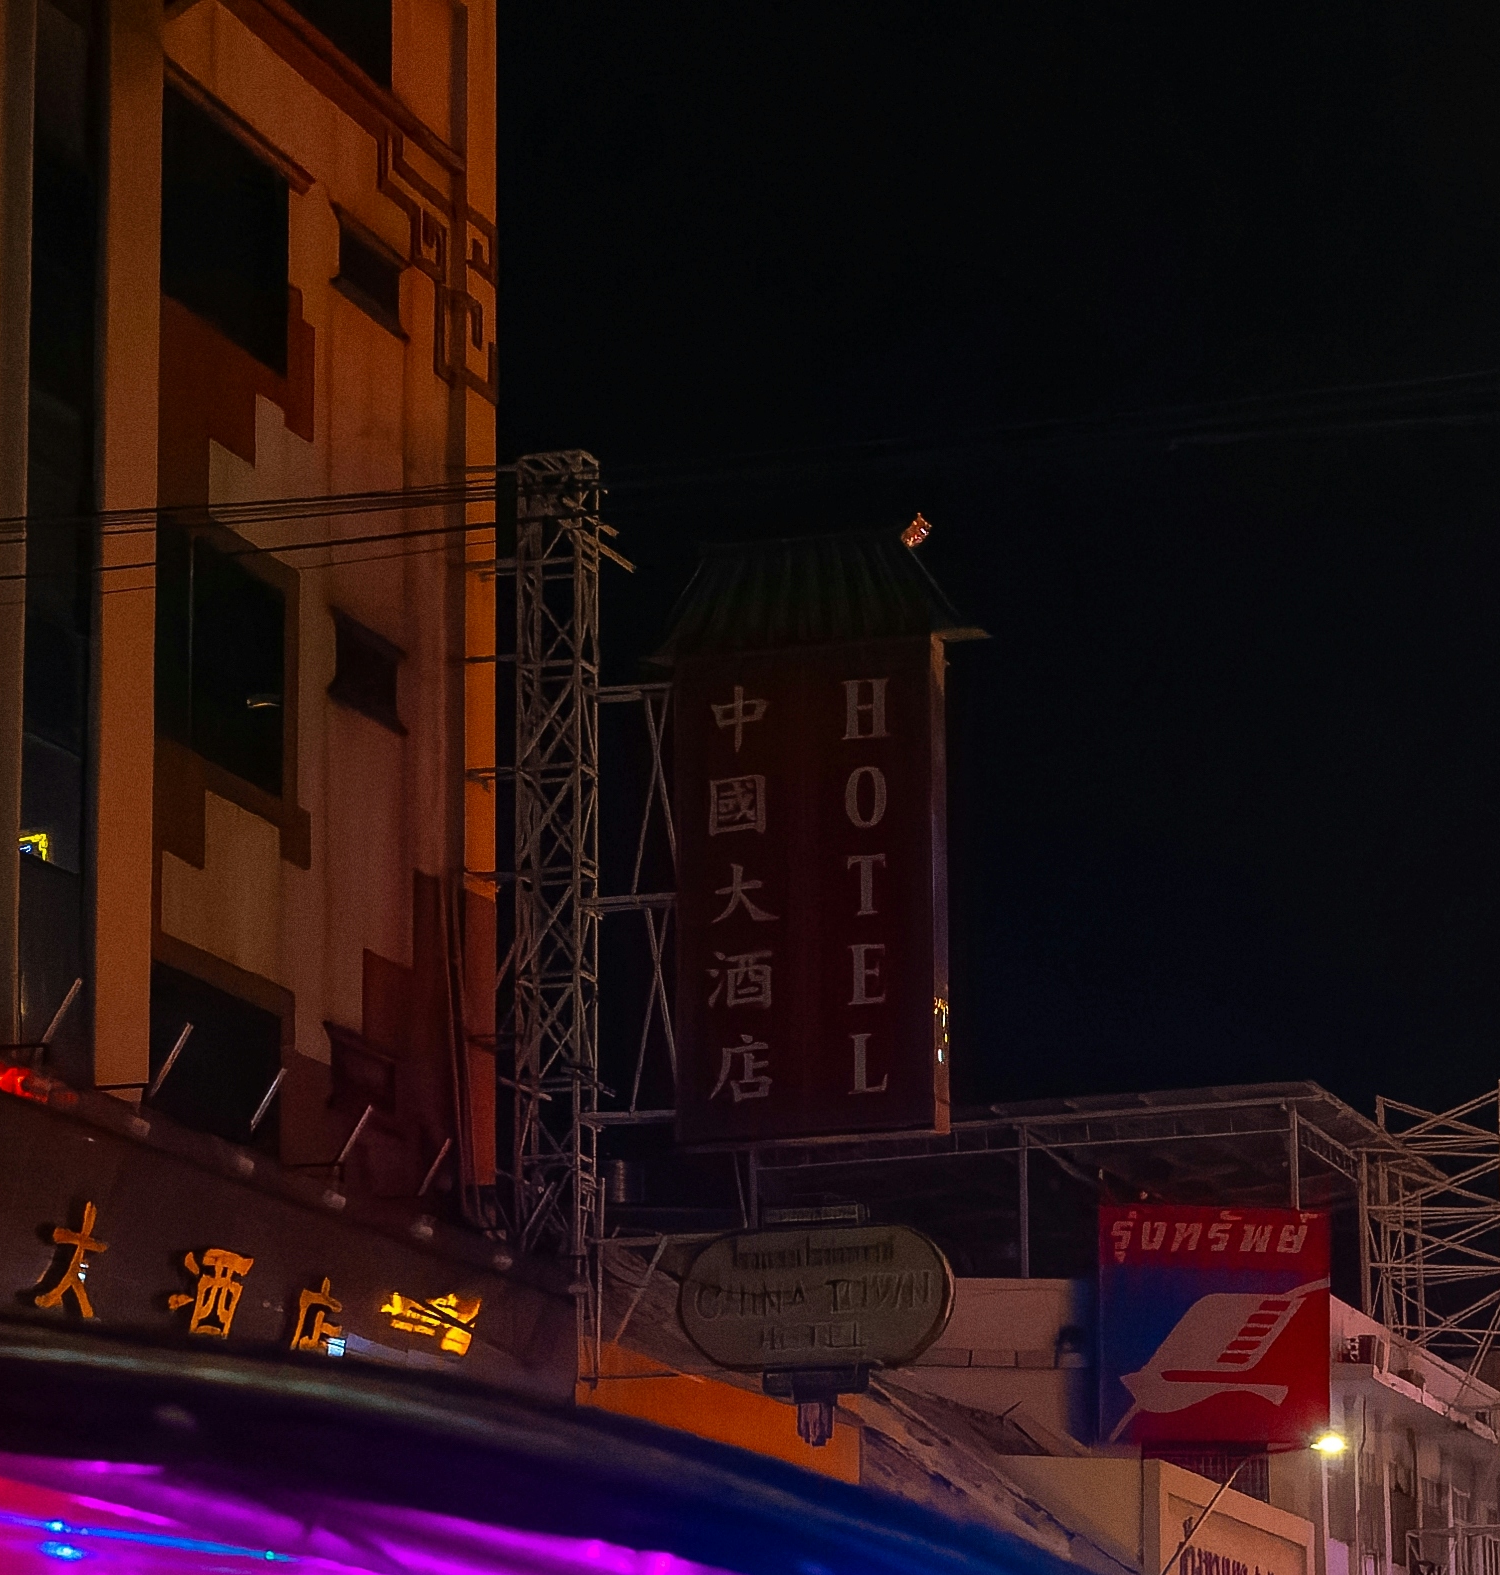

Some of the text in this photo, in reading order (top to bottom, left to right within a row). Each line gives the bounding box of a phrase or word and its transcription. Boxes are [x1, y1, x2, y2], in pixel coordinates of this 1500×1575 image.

[707, 685, 779, 1104] 中國大酒店
[843, 678, 890, 1097] HOTEL
[1111, 1209, 1317, 1261] รุ่งทรัพย์
